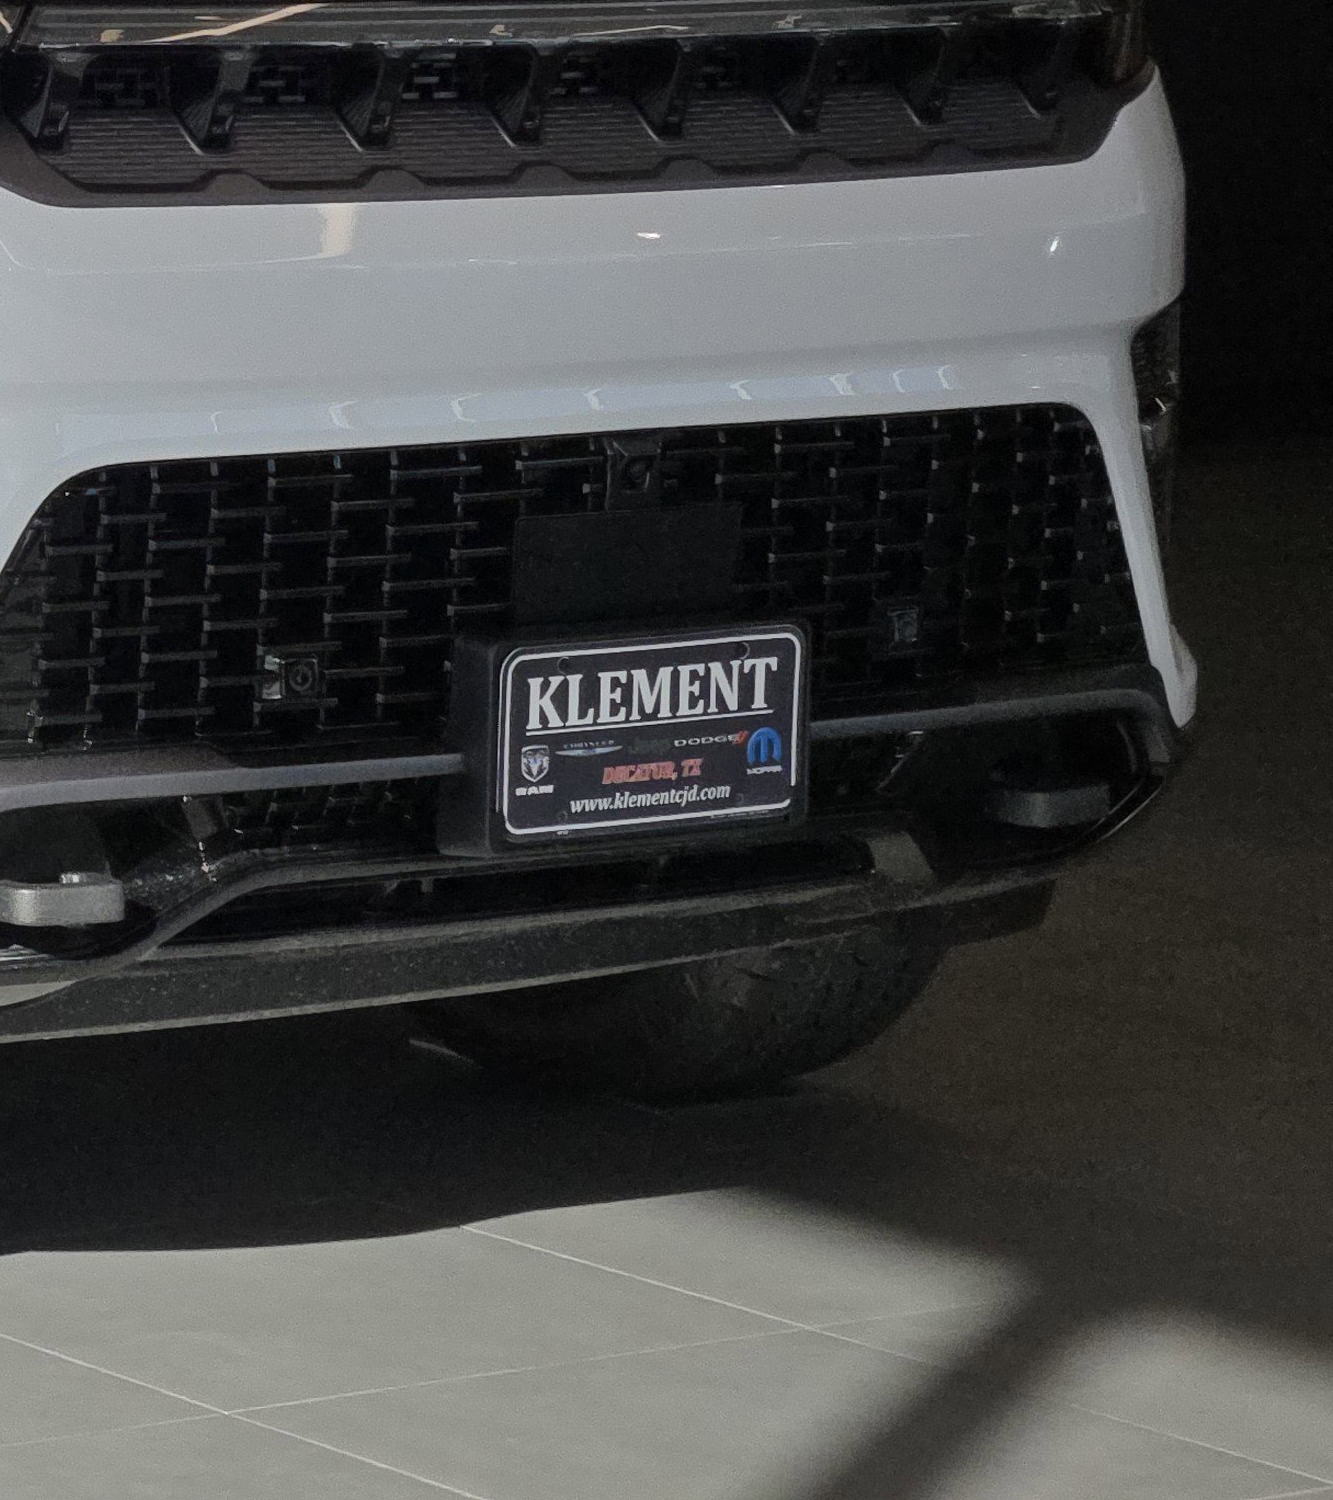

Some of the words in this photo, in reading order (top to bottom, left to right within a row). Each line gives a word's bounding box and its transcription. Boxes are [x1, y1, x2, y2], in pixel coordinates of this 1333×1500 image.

[525, 656, 778, 730] KLEMENT
[674, 733, 739, 748] DODGE
[570, 784, 731, 814] www.klementcjd.com
